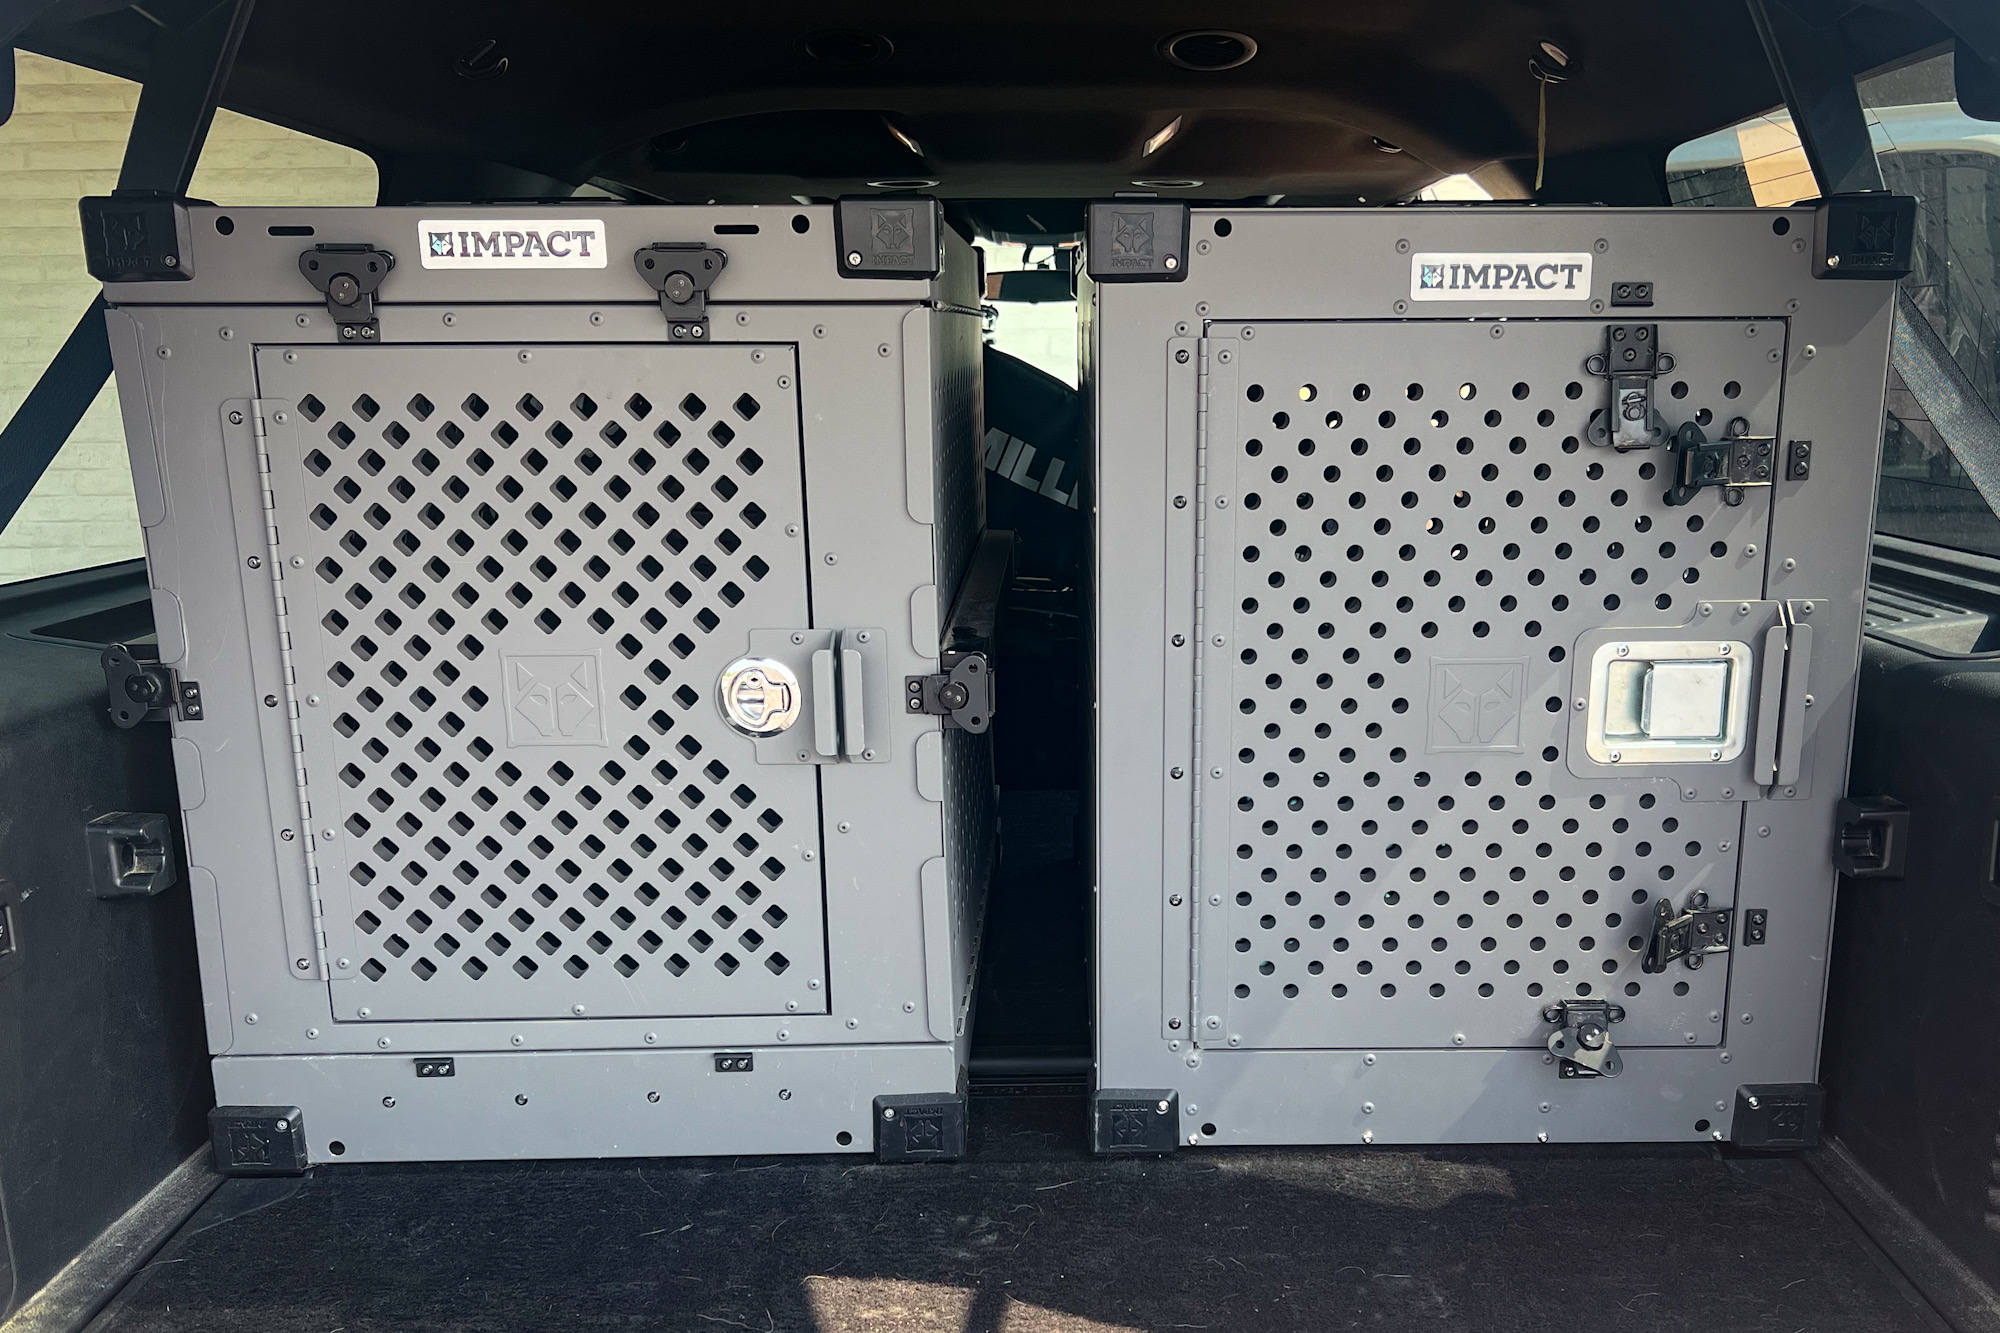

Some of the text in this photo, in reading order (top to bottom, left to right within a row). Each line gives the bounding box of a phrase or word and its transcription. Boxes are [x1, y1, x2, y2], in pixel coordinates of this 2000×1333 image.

[458, 231, 596, 257] IMPACT
[872, 255, 915, 265] IMPACT
[1449, 263, 1583, 289] IMPACT
[984, 427, 1079, 510] ILL
